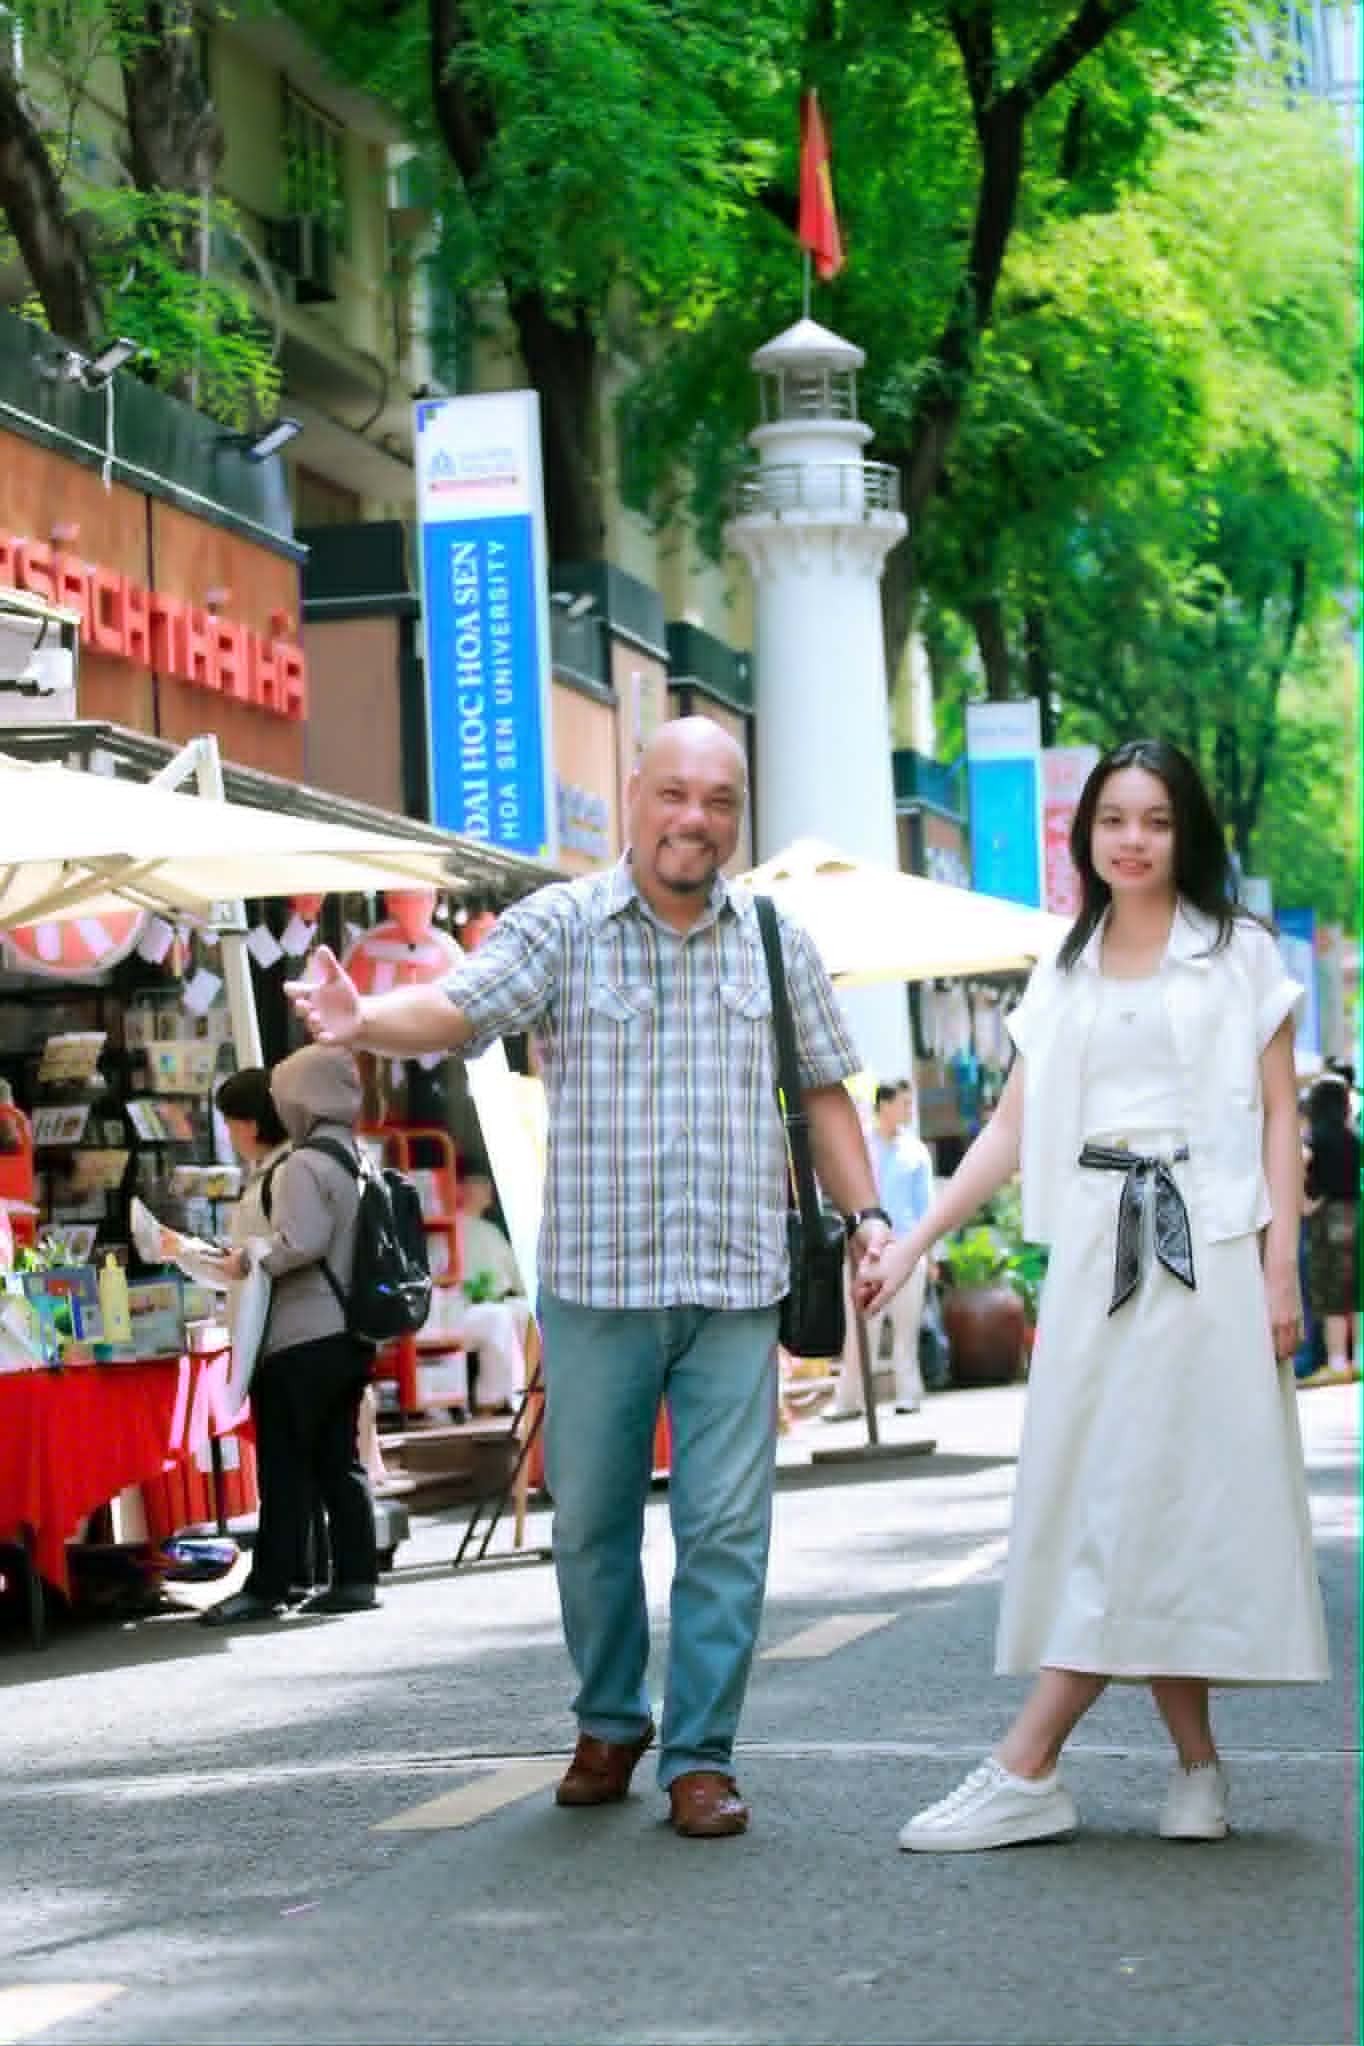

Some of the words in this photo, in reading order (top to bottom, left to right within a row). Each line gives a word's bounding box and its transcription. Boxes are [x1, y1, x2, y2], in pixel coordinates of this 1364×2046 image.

[451, 540, 480, 605] SEN
[455, 610, 482, 688] HOA
[487, 540, 513, 705] UNIVERSITY
[495, 717, 518, 769] SEN
[499, 783, 521, 839] HOA
